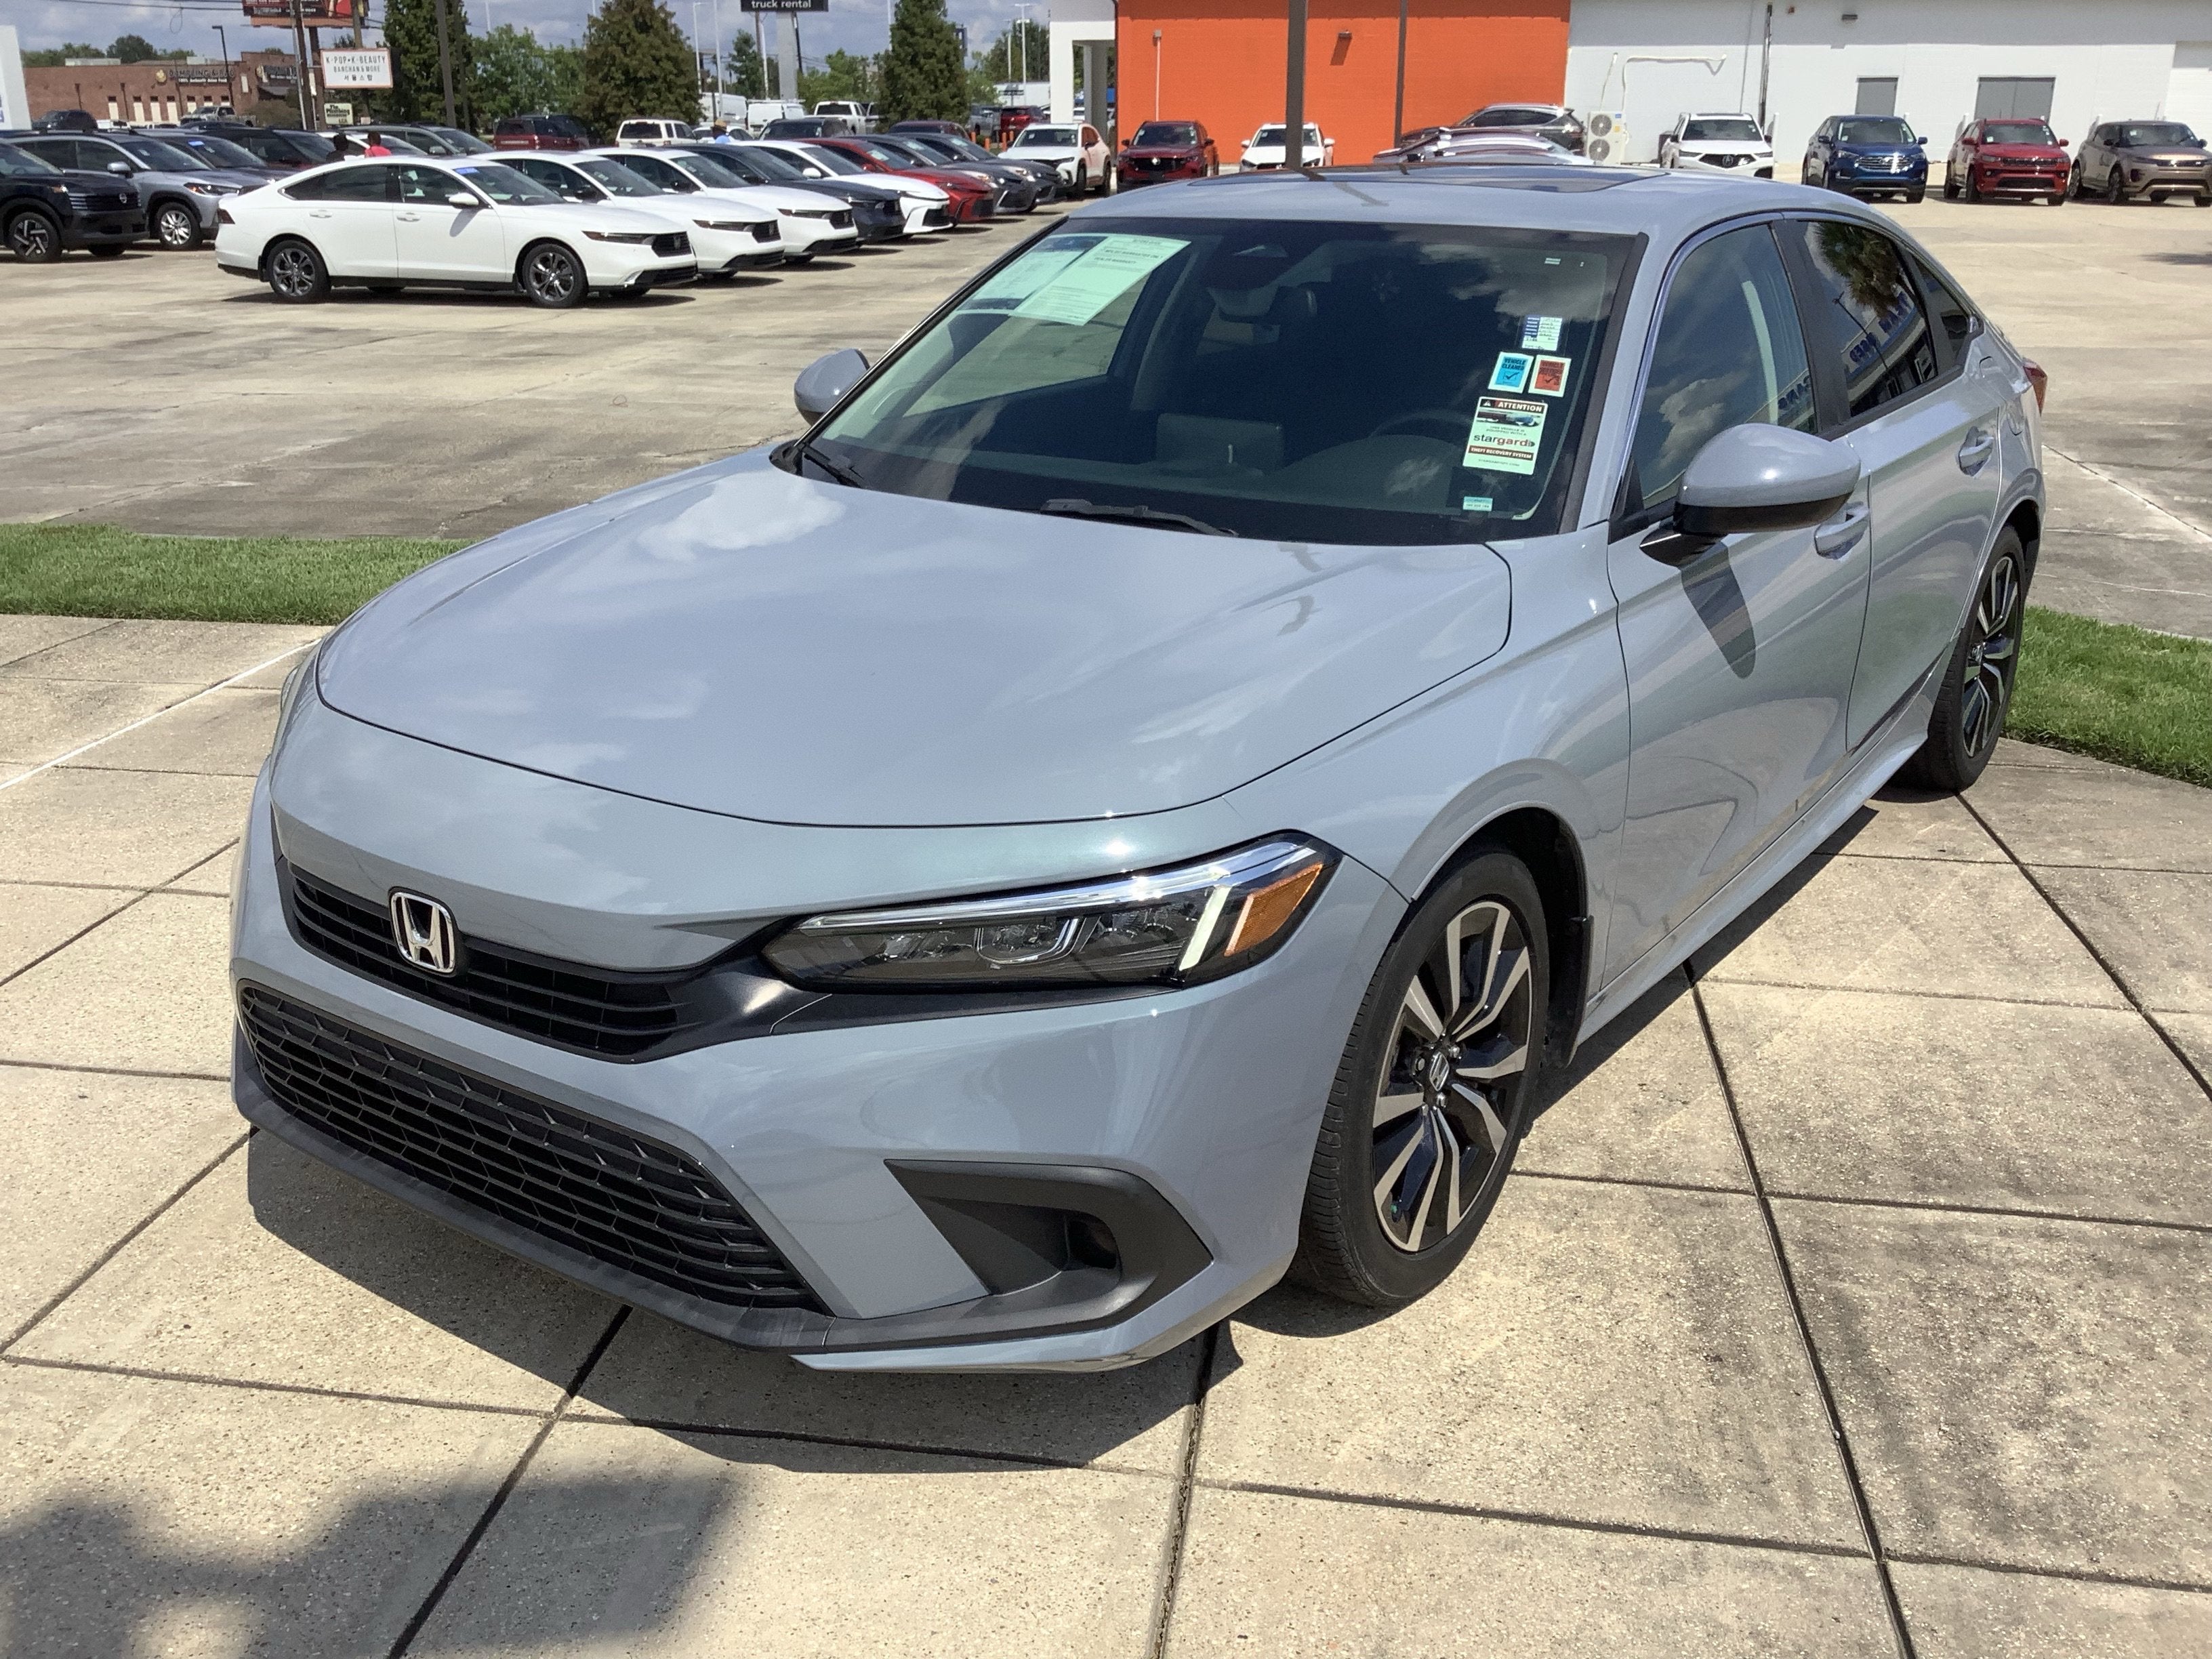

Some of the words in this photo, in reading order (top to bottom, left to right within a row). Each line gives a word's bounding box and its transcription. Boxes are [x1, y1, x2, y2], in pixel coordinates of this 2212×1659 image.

[752, 0, 778, 8] truck
[781, 0, 811, 8] rental
[1504, 357, 1526, 365] VEHICLE
[1498, 401, 1542, 412] ATTENTION
